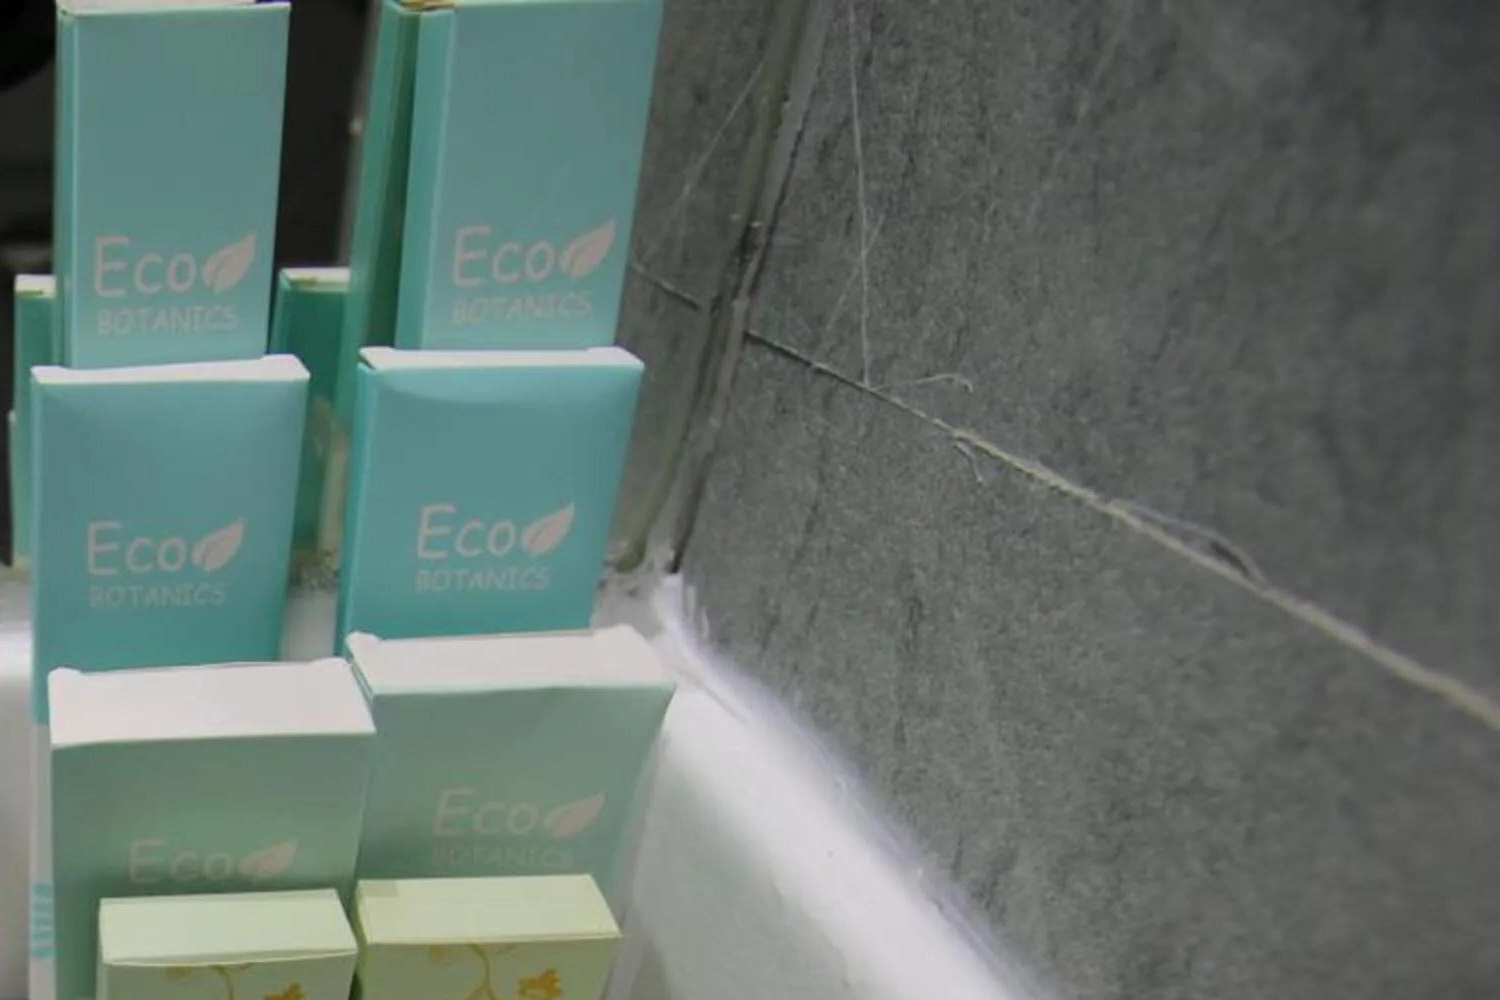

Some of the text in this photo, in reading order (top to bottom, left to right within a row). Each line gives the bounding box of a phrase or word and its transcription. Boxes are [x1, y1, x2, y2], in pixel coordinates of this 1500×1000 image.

[93, 234, 198, 298] Eco
[453, 224, 556, 288] Eco
[96, 304, 240, 335] BOTANICS
[451, 290, 592, 325] BOTANICS
[86, 520, 188, 577] Eco
[416, 502, 517, 560] Eco
[88, 582, 228, 609] BOTANICS
[415, 565, 553, 594] BOTANICS
[433, 786, 541, 837] Eco
[128, 836, 233, 883] Eco
